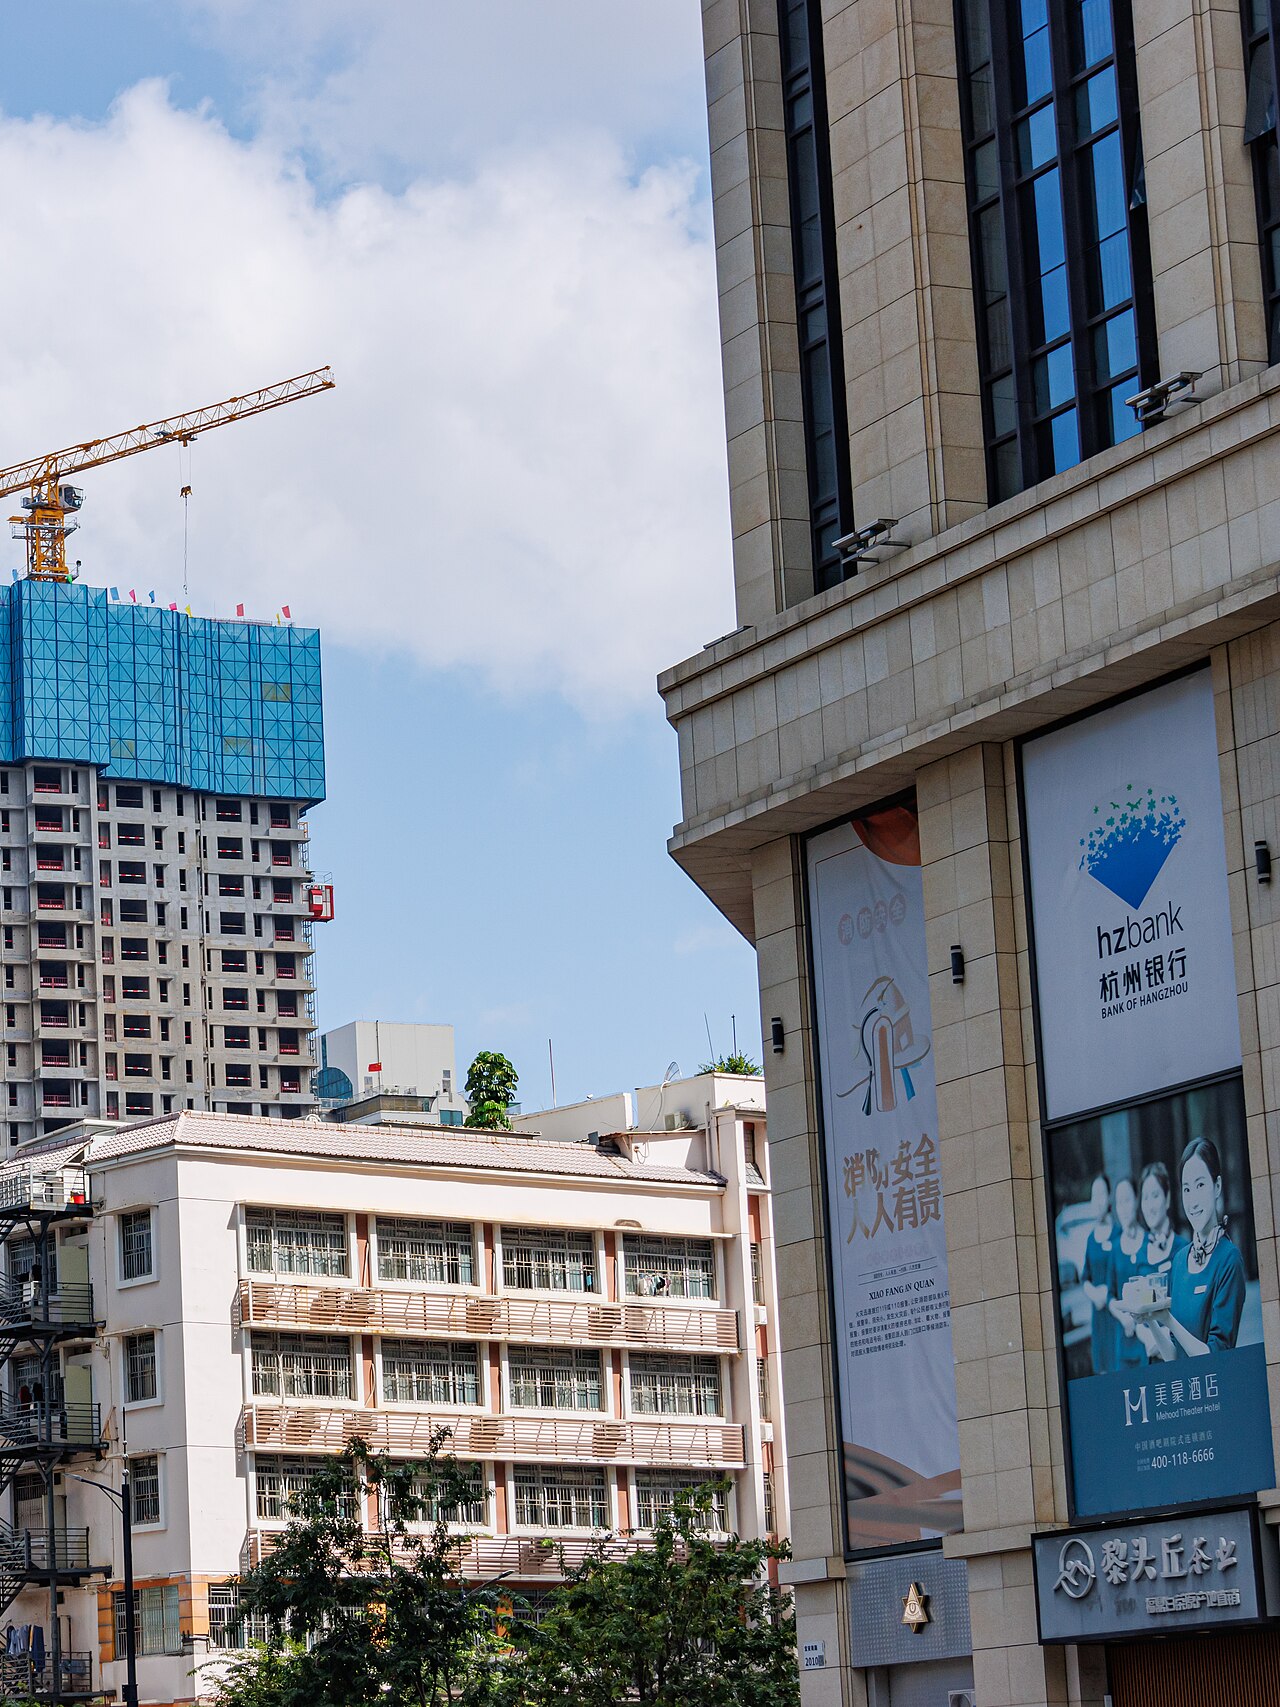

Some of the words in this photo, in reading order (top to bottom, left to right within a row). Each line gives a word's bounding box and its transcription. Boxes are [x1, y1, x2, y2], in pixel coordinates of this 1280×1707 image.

[1097, 900, 1184, 959] hzbank
[1099, 947, 1187, 1003] 杭州银行
[1101, 1002, 1125, 1019] BANK
[1126, 998, 1138, 1011] OF
[1139, 981, 1189, 1007] HANGZHOU
[843, 1133, 937, 1199] 消防安全
[846, 1178, 942, 1245] 人人有责
[868, 1289, 885, 1300] XIAO
[885, 1285, 904, 1297] FANG
[913, 1278, 935, 1291] QUAN
[1154, 1373, 1219, 1407] 美豪酒店
[1155, 1409, 1179, 1421] Mehood
[1180, 1405, 1203, 1417] Theater
[1204, 1402, 1220, 1411] Hotel
[1151, 1447, 1215, 1469] 400-118-6666
